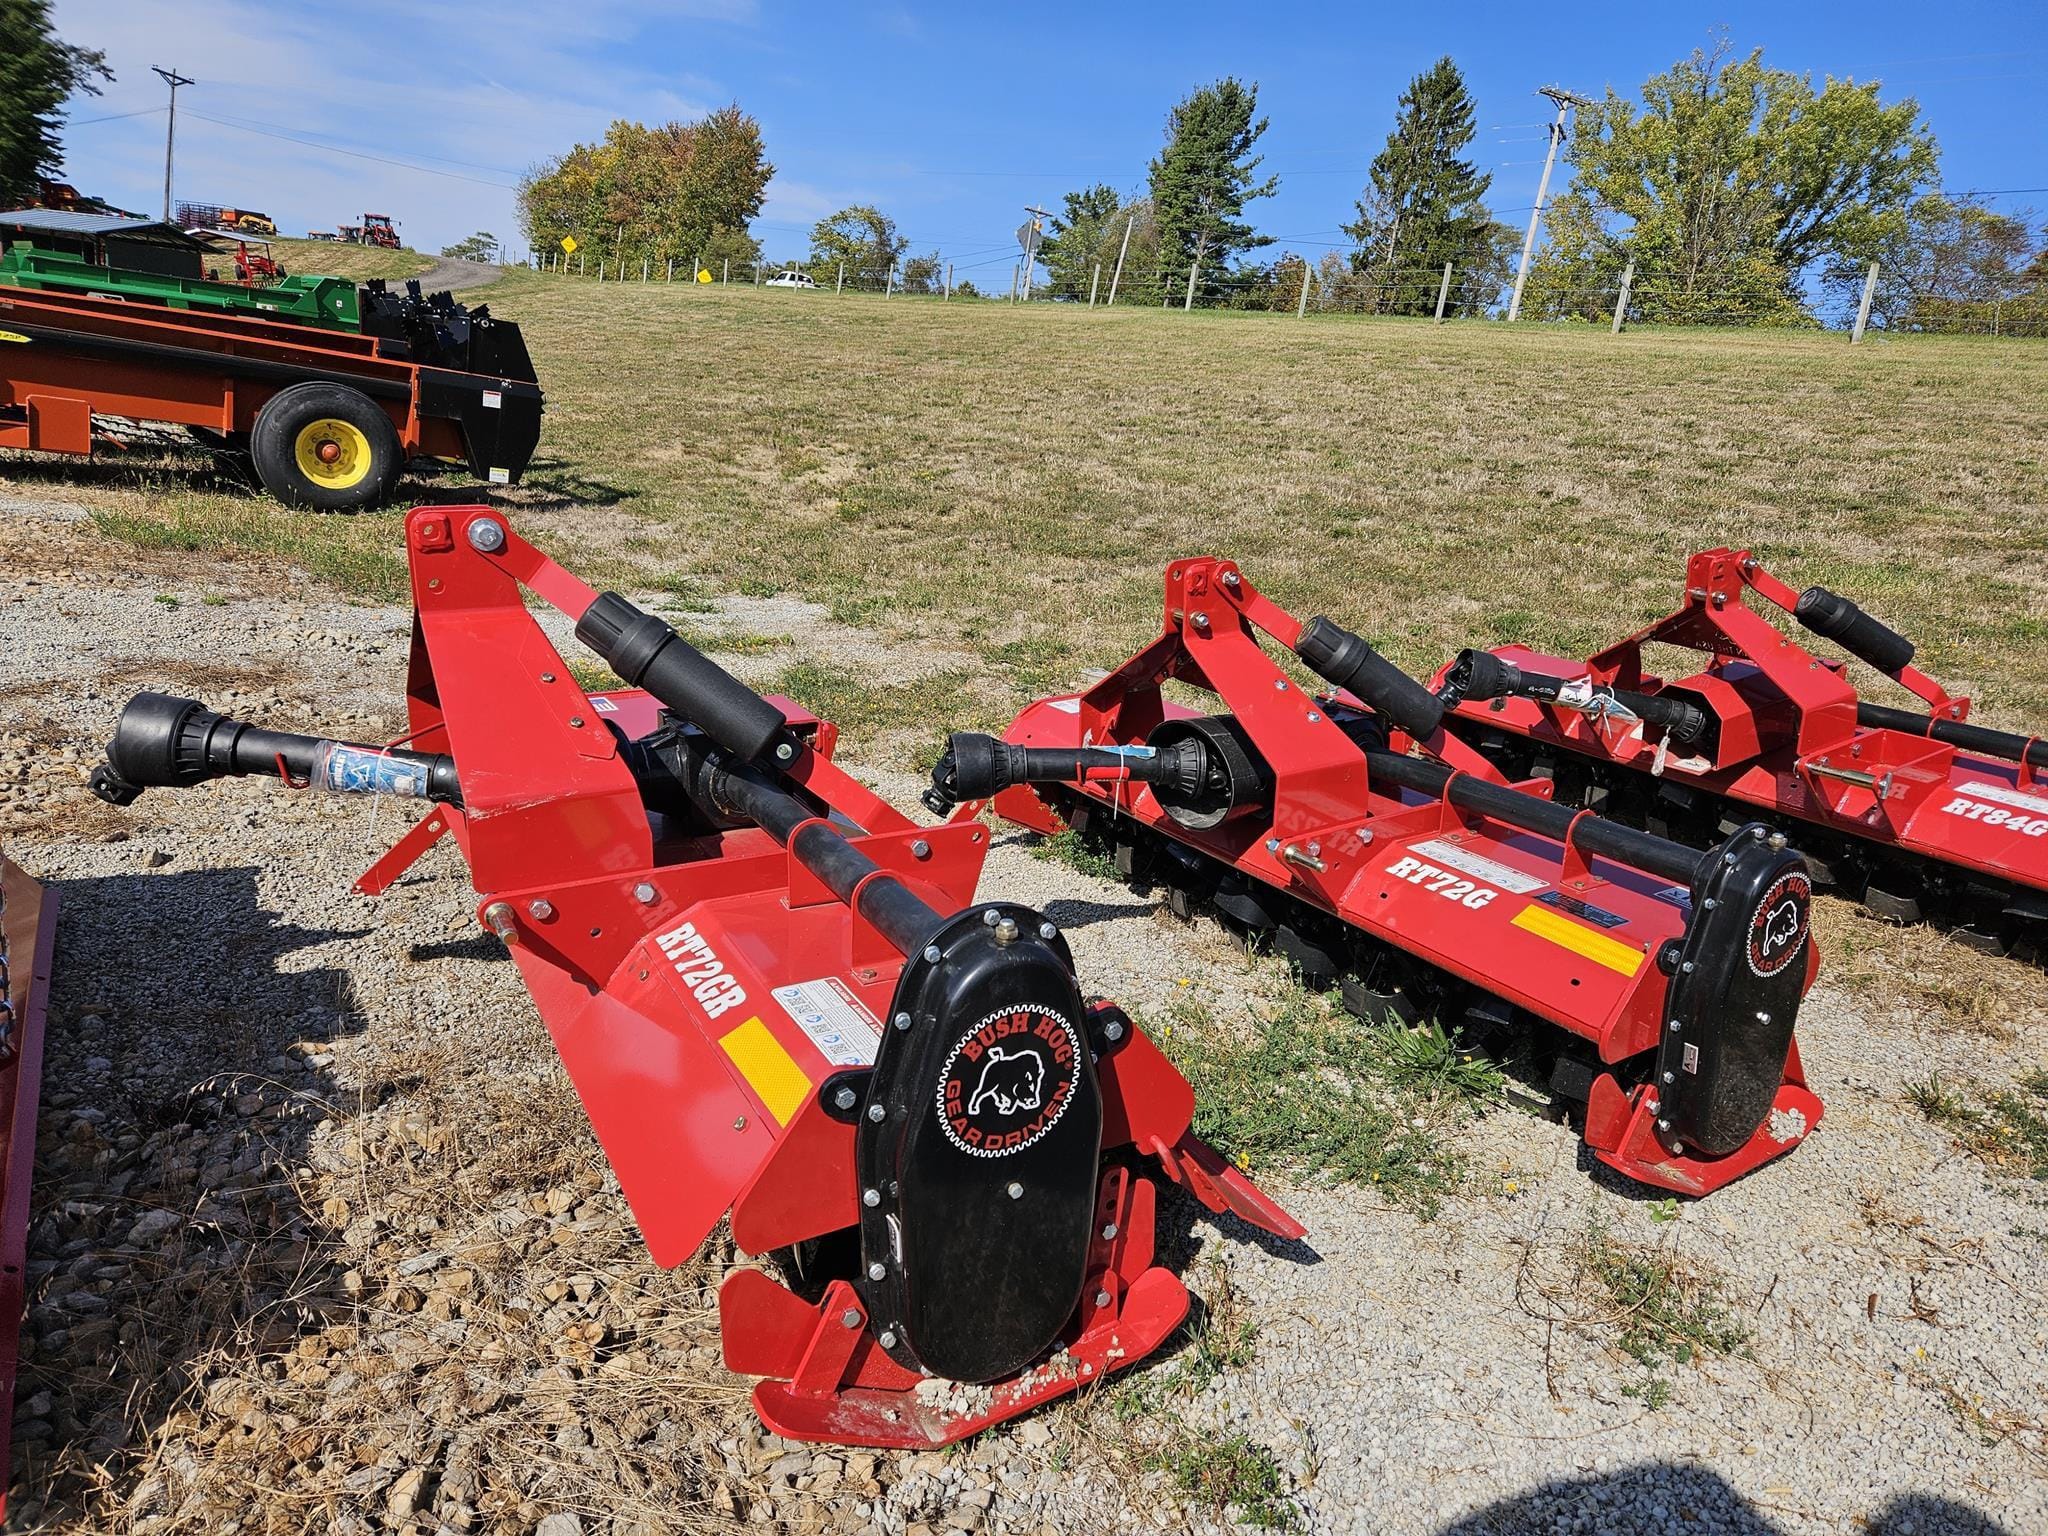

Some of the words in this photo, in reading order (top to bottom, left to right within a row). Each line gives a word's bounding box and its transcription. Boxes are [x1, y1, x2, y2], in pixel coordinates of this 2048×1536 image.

[1940, 797, 2048, 837] RT84G
[1384, 856, 1499, 910] RT72G
[1754, 884, 1785, 928] BUSH
[1787, 877, 1809, 900] HOG
[655, 921, 747, 1020] RT72GR
[1751, 941, 1773, 971] GEAR
[961, 1012, 1030, 1063] BUSH
[1033, 1015, 1074, 1064] HOG
[945, 1080, 983, 1146] GEAR
[983, 1081, 1071, 1149] DRIVEN
